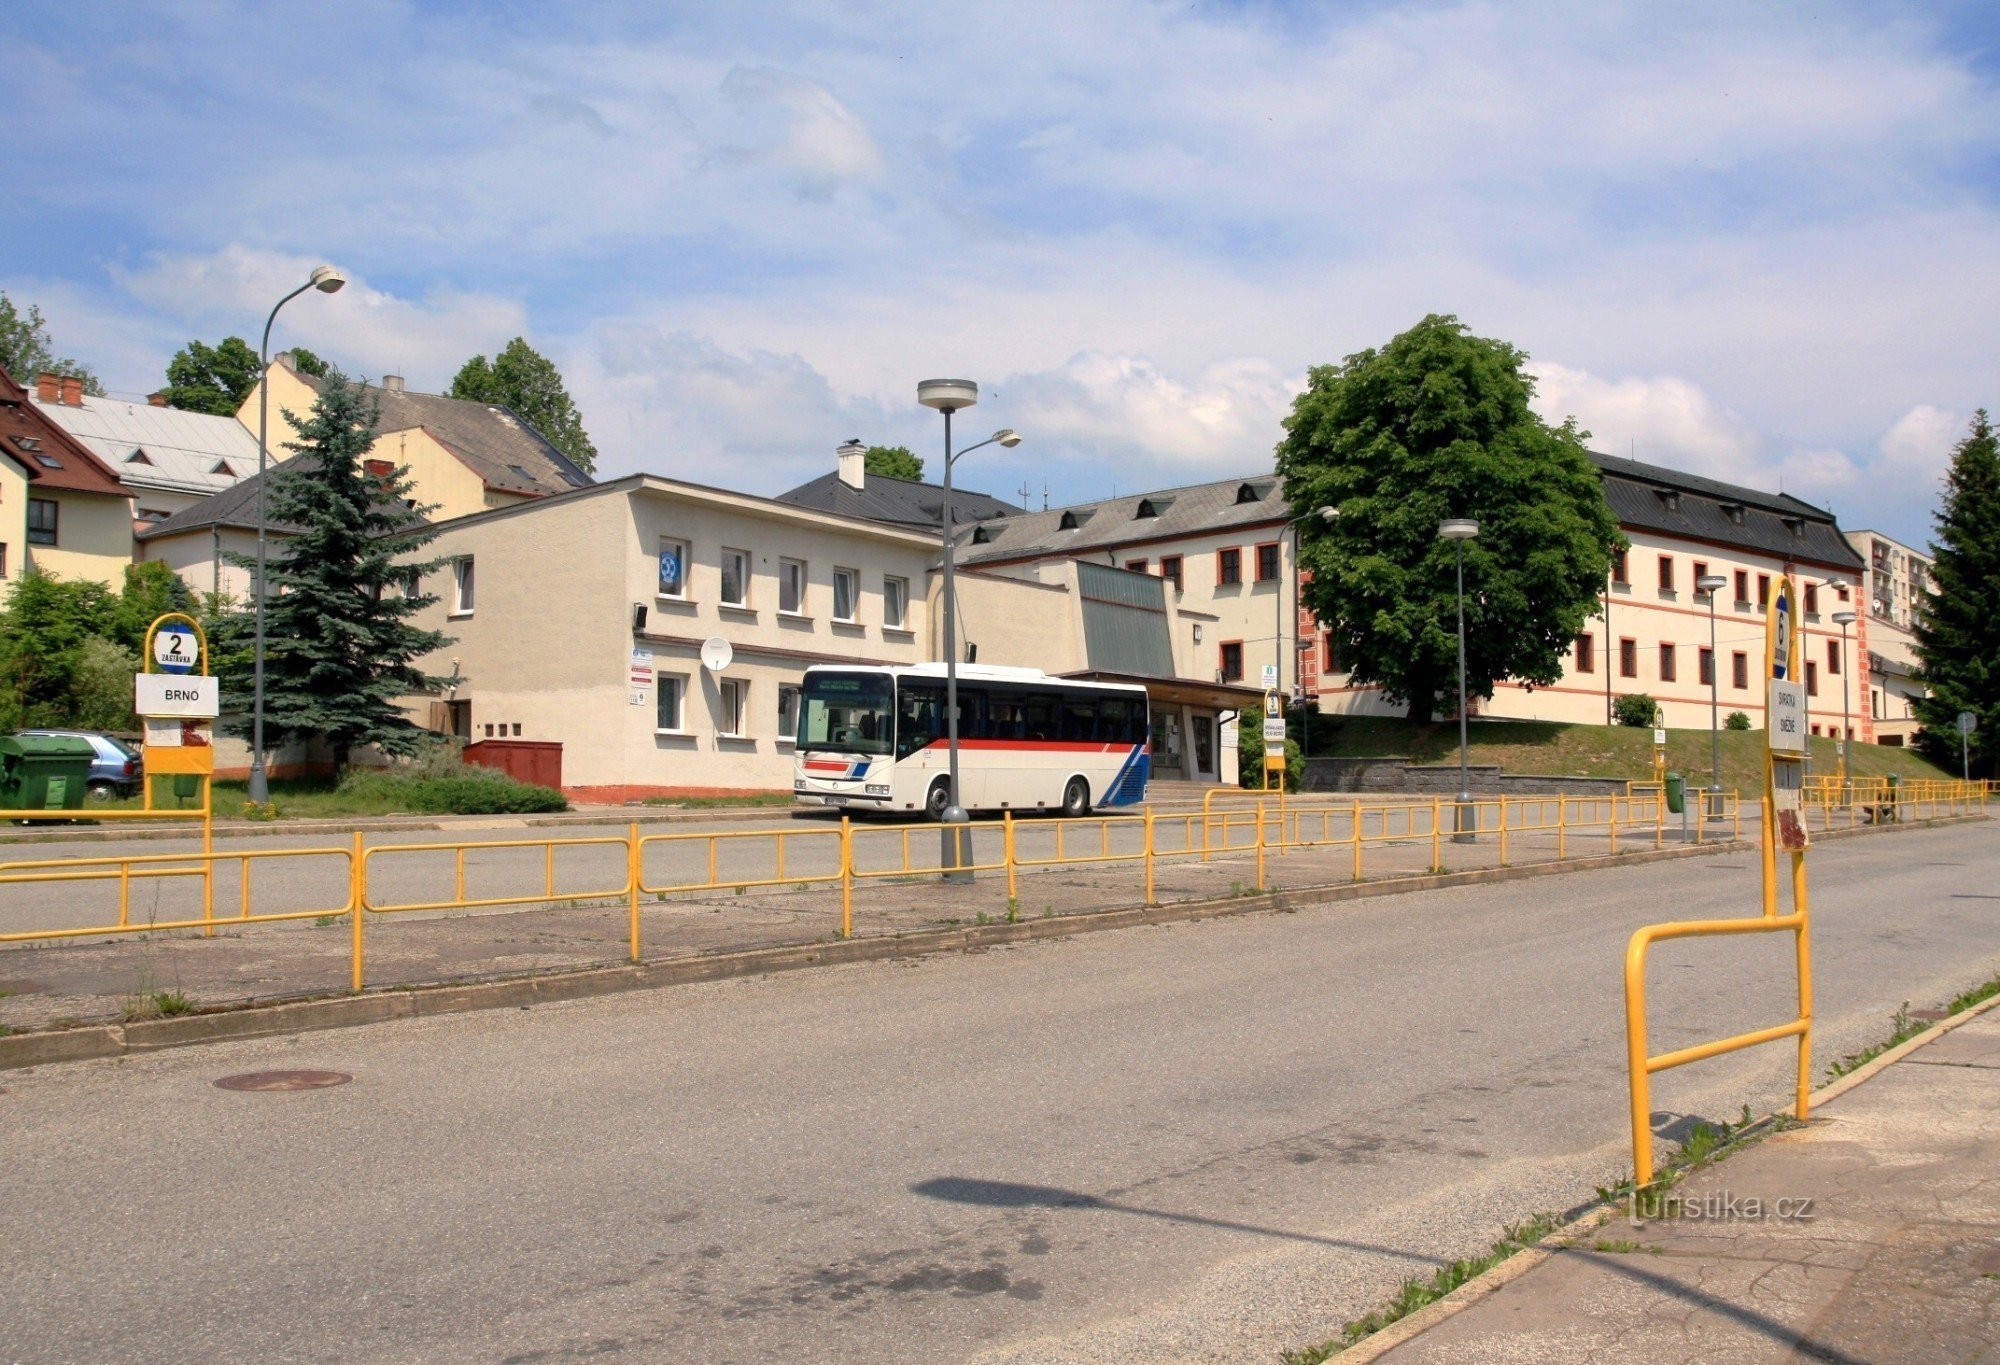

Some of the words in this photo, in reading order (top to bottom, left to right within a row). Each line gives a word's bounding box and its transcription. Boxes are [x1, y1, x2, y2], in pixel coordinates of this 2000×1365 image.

[1778, 612, 1784, 646] 6
[170, 634, 182, 655] 2
[161, 653, 191, 664] ZASTÁVKA
[165, 689, 199, 701] BRNO
